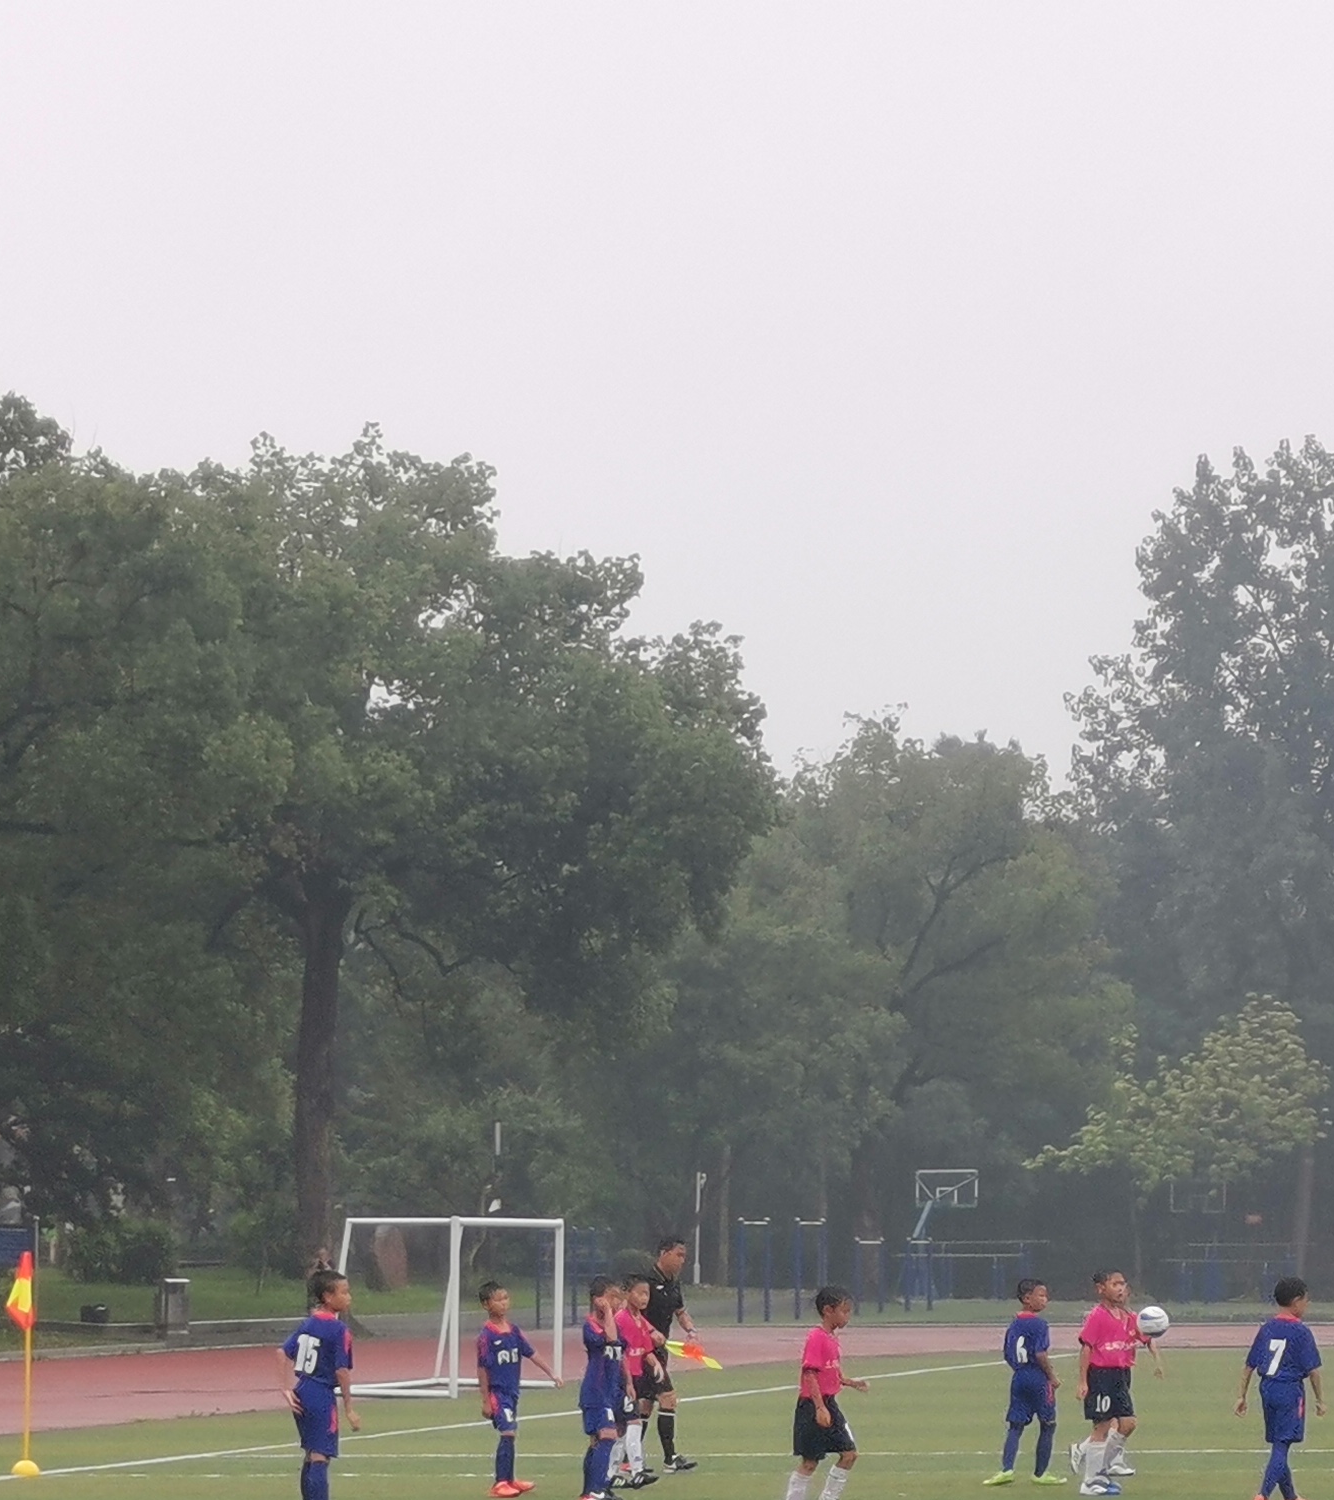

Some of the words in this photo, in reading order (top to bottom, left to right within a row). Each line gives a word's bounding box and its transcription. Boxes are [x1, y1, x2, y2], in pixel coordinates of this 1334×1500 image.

[294, 1333, 321, 1375] 15
[1016, 1335, 1029, 1364] 6
[1265, 1338, 1287, 1376] 7
[1094, 1393, 1112, 1414] 10
